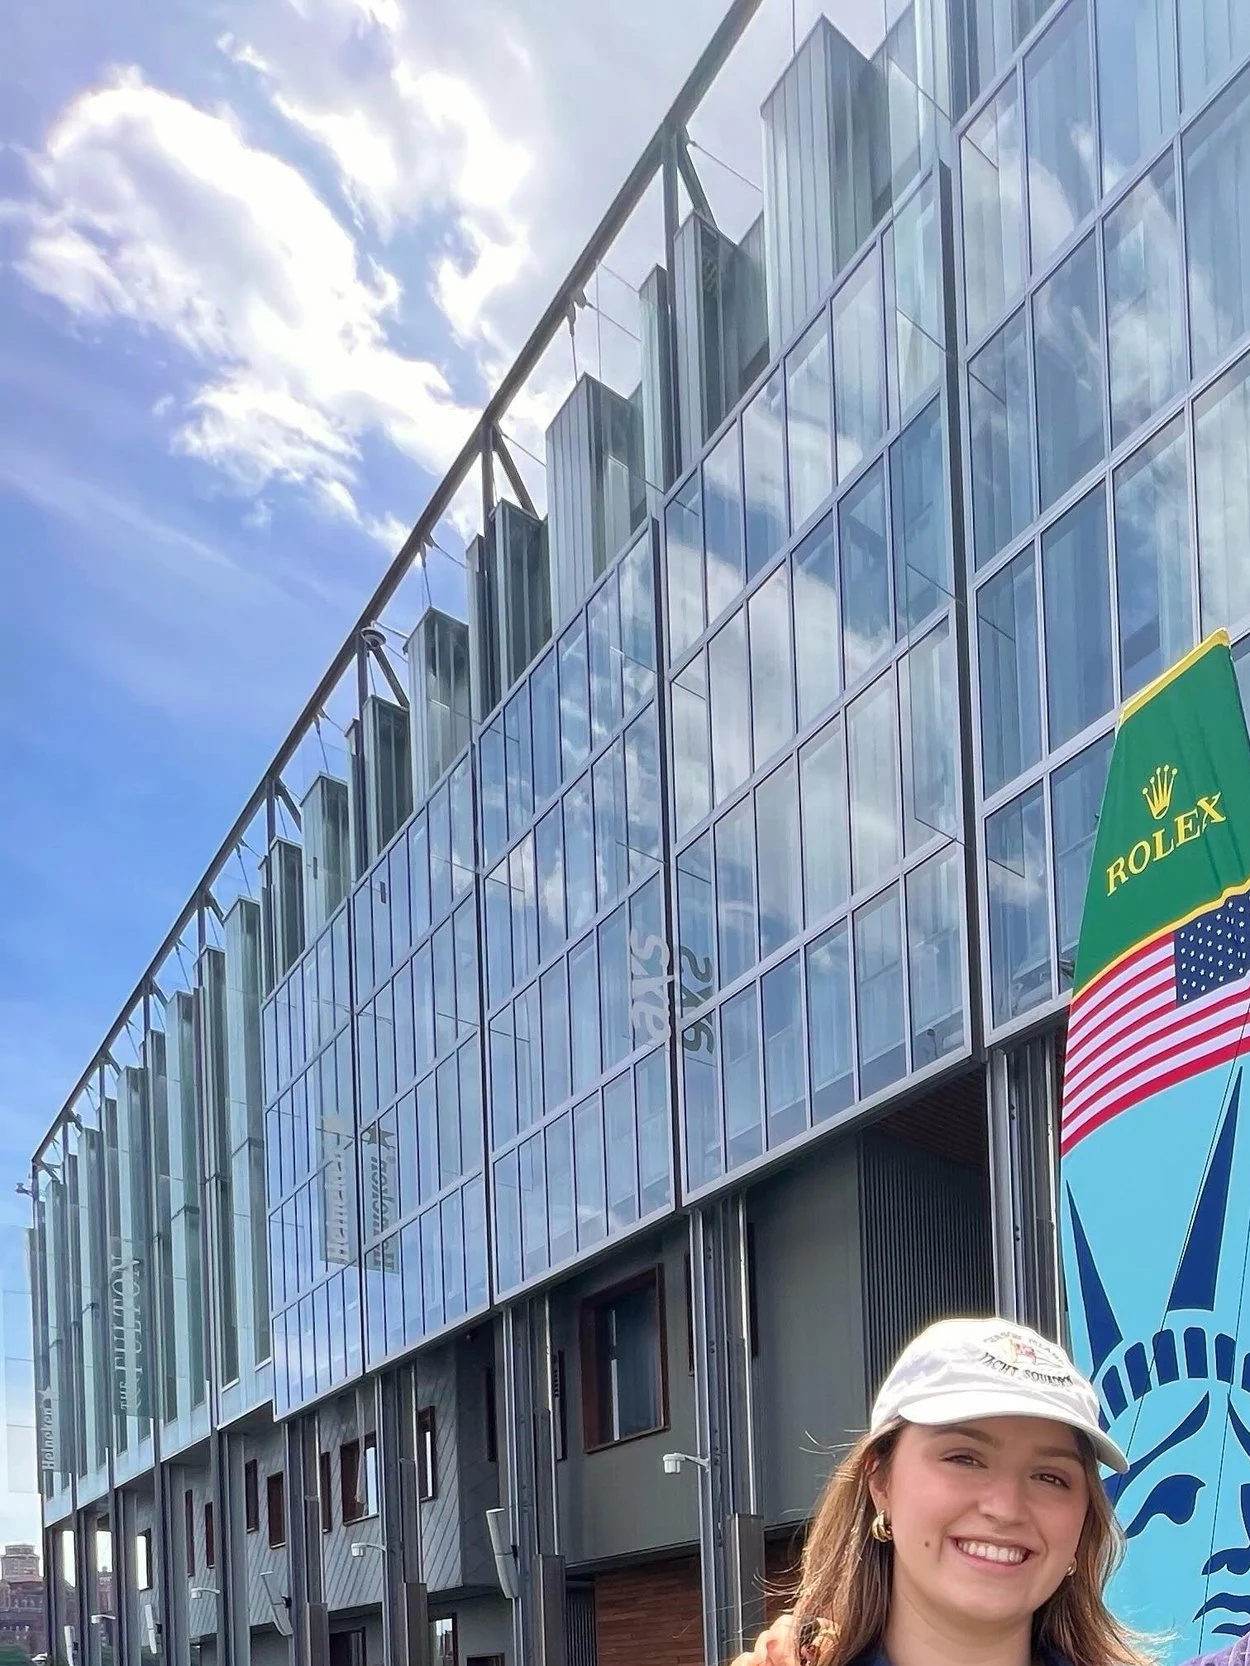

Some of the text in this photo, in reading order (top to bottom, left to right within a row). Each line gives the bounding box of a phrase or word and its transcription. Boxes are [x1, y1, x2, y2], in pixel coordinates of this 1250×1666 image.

[1105, 791, 1227, 897] ROLEX
[111, 1254, 143, 1373] FULTON
[41, 1407, 55, 1470] Heineken
